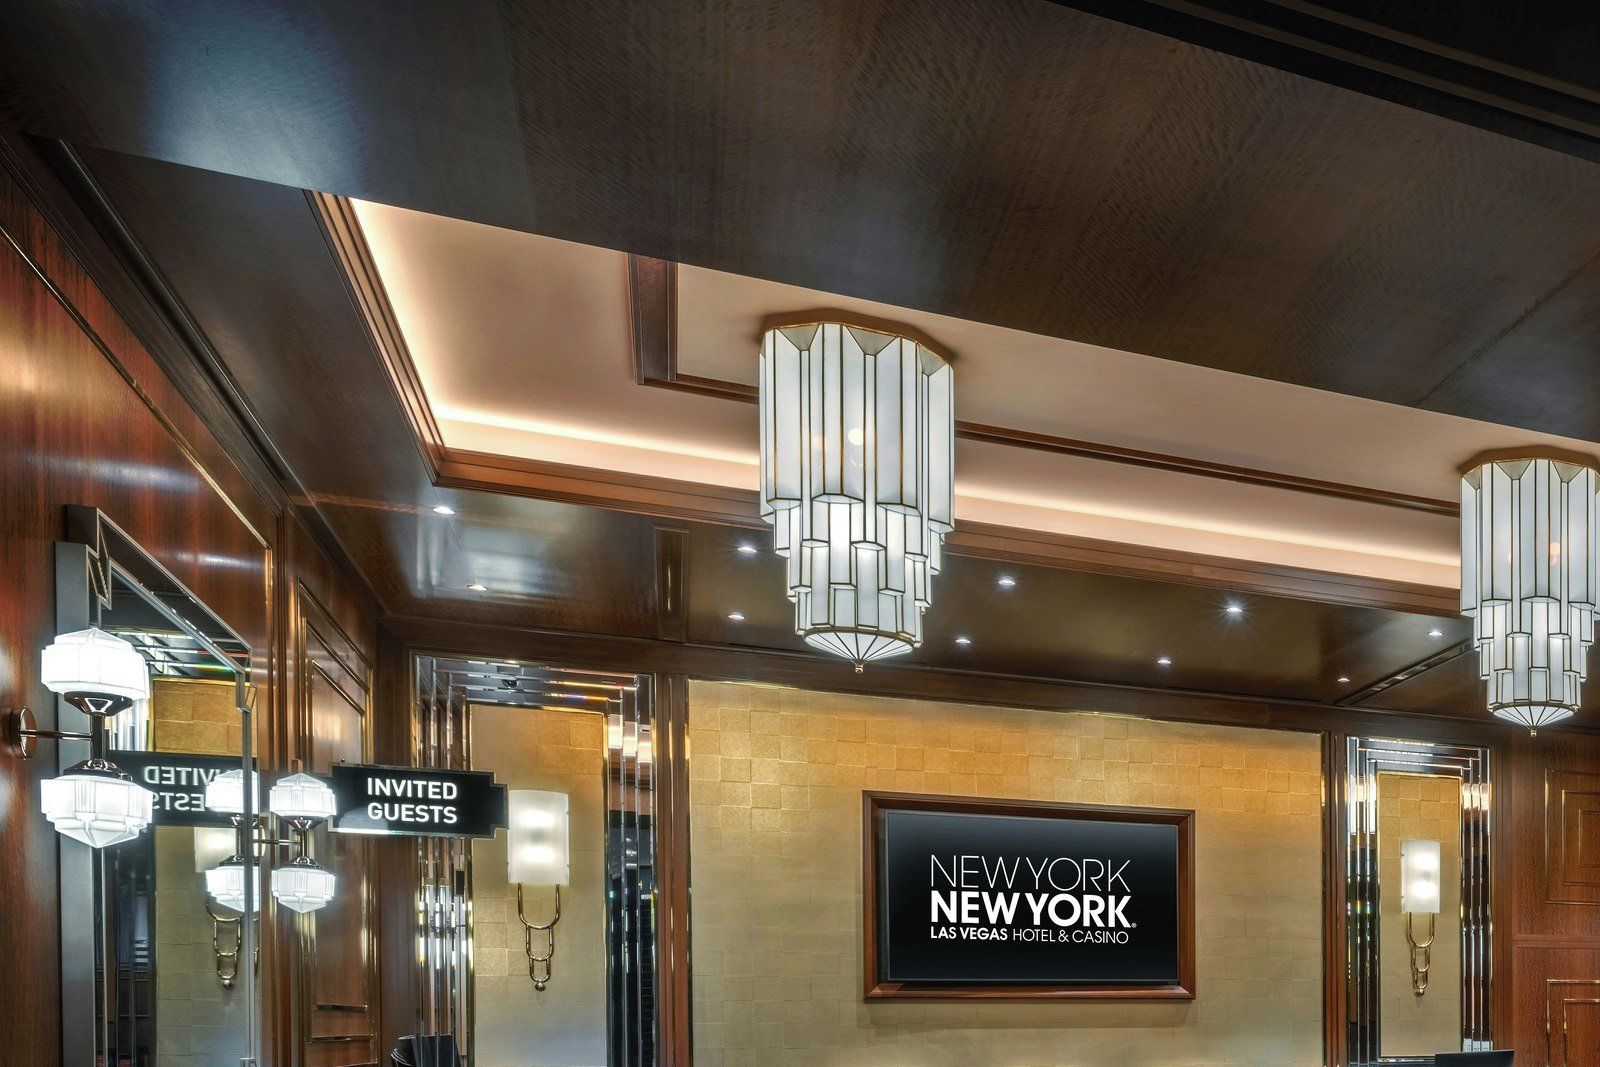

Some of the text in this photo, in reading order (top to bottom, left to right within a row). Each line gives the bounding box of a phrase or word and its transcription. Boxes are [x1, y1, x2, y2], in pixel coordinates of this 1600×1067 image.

[367, 777, 458, 800] INVITED
[367, 802, 458, 824] GUESTS
[930, 854, 1131, 892] NEW YORK
[930, 890, 1132, 928] NEW YORK
[930, 926, 1129, 944] LAS VEGAS HOTEL & CASINO
